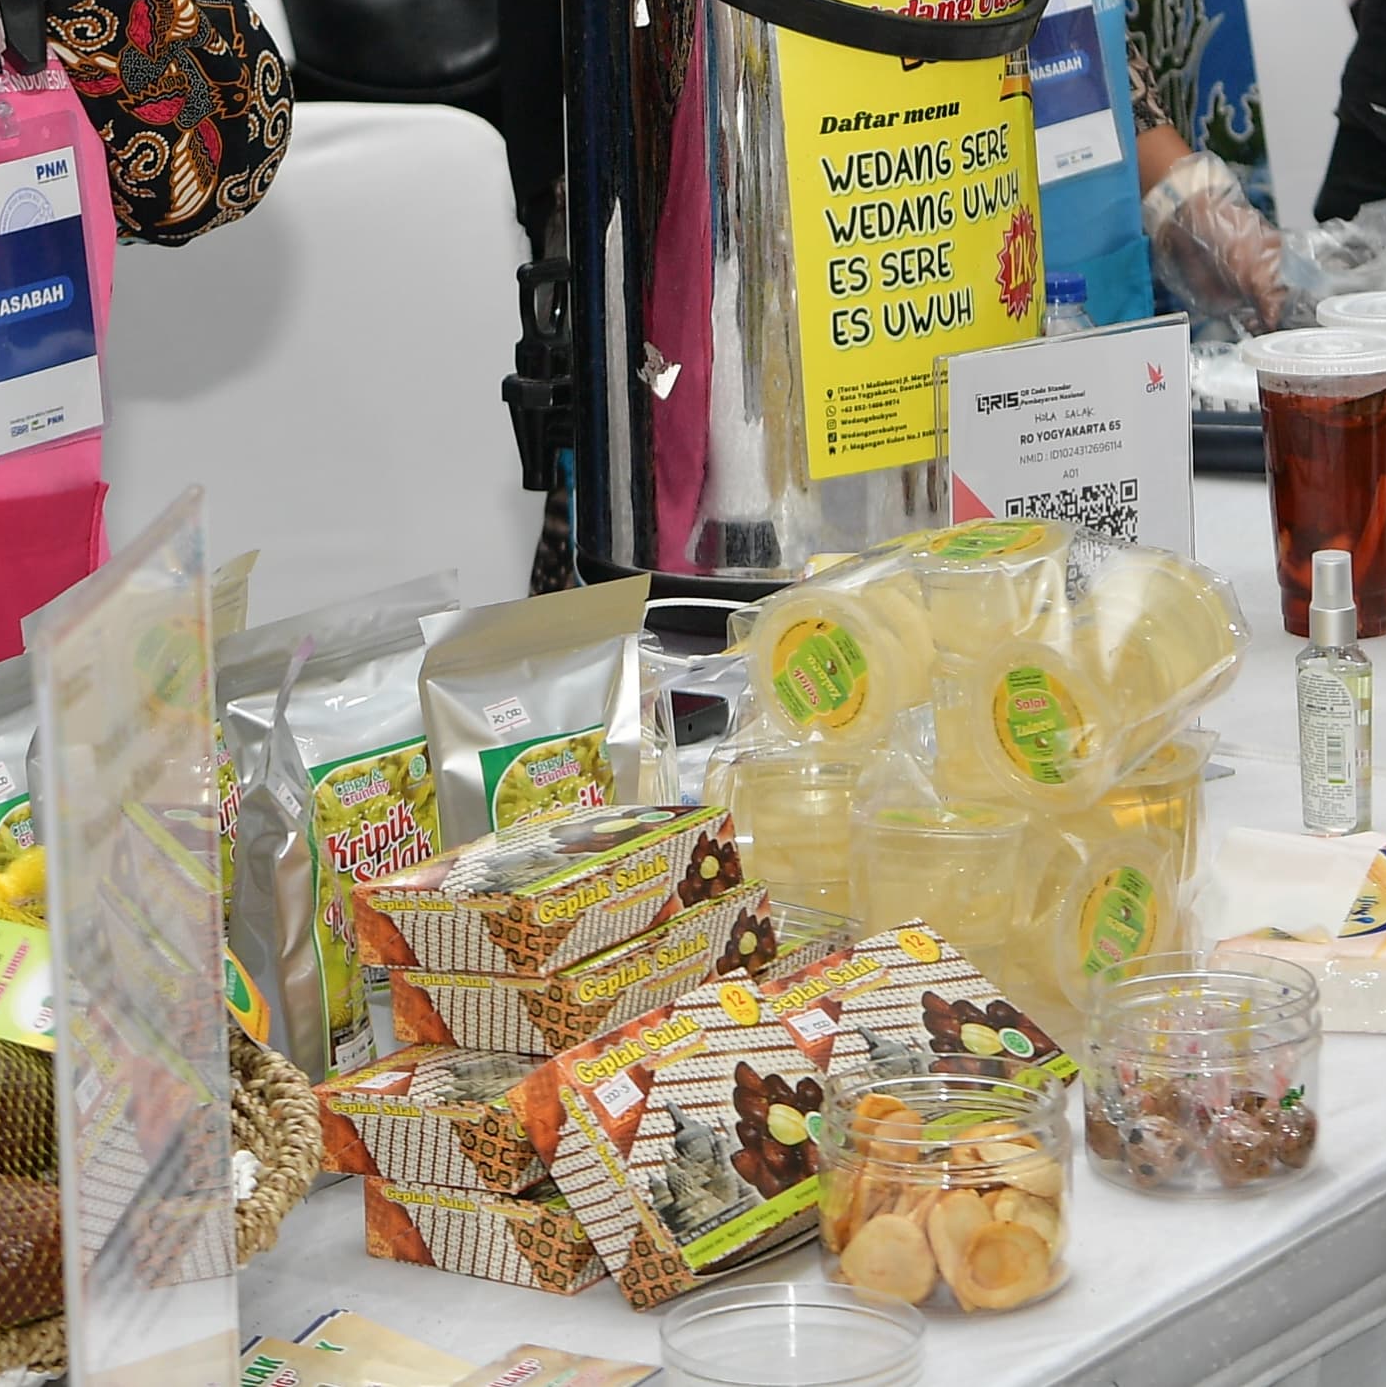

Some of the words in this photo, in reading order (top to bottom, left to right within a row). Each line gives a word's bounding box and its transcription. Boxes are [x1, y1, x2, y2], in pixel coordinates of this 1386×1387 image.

[1030, 56, 1083, 82] NASABAH
[819, 111, 900, 135] Daftar
[903, 101, 960, 125] menu
[36, 159, 68, 180] PNM
[821, 141, 951, 192] WEDANG
[961, 123, 1008, 170] SERE
[825, 191, 953, 244] WEDANG
[963, 171, 1019, 219] UWUH
[829, 256, 867, 296] ES
[881, 242, 951, 287] SERE
[1008, 231, 1033, 291] 12K
[832, 308, 870, 346] ES
[883, 287, 972, 336] UWUH
[1146, 381, 1166, 393] GPN
[977, 392, 1020, 415] QRIS
[1020, 433, 1034, 445] RO
[1037, 422, 1106, 443] YOGYAKARTA
[1109, 420, 1121, 431] 65
[1020, 452, 1043, 465] NMID
[1015, 696, 1048, 711] Salak
[527, 756, 562, 777] Crispy
[534, 762, 581, 788] Crunchy
[334, 774, 370, 796] Crispy
[371, 767, 384, 782] &
[342, 779, 390, 807] Crunchy
[327, 801, 415, 871] Kripik
[354, 830, 432, 883] Salak
[539, 881, 610, 925] Geplak
[616, 855, 669, 892] Salak
[371, 898, 413, 912] Geplak
[417, 899, 454, 912] Salak
[905, 934, 925, 949] 12
[407, 972, 451, 987] Geplak
[455, 975, 492, 989] Salak
[578, 960, 650, 1003] Geplak
[656, 933, 710, 969] Salak
[825, 956, 881, 986] Salak
[726, 990, 747, 1008] 12
[575, 1038, 647, 1084] Geplak
[642, 1014, 700, 1051] Salak
[331, 1100, 378, 1116] Geplak
[382, 1103, 422, 1118] Salak
[385, 1187, 434, 1206] Geplak
[437, 1194, 478, 1212] Salak
